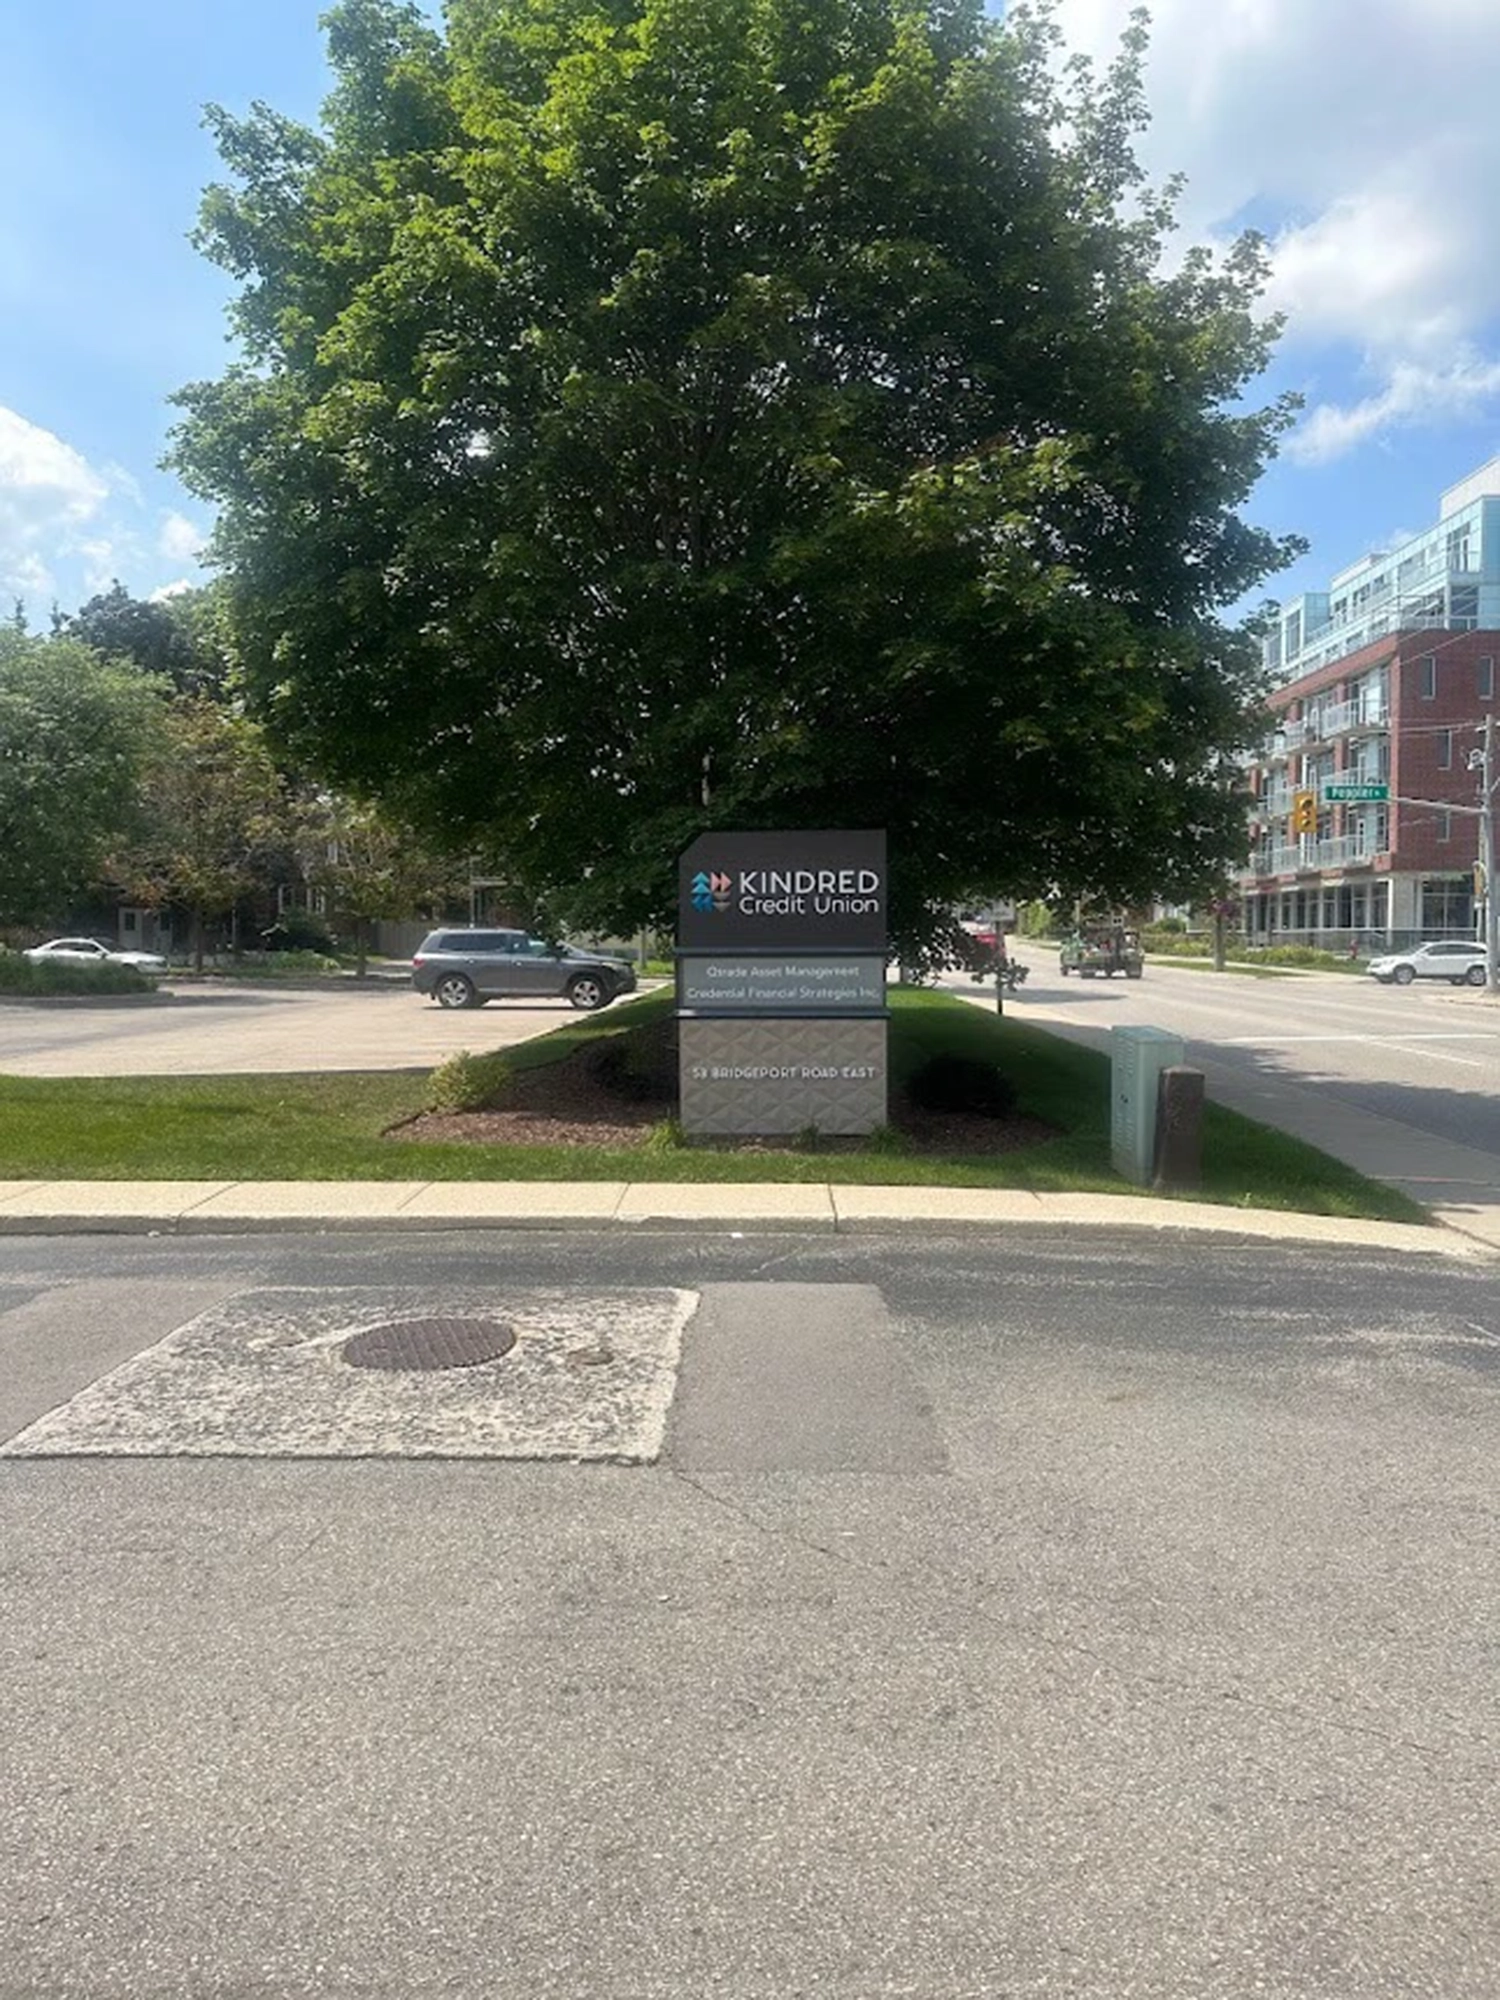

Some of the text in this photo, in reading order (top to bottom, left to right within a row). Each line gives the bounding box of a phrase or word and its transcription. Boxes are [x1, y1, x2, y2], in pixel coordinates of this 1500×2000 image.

[740, 870, 879, 894] KINDRED
[740, 895, 879, 915] Credit Union
[750, 966, 782, 978] Asset
[785, 965, 860, 980] Management
[687, 987, 745, 999] Credential
[748, 986, 797, 999] Financial
[799, 986, 857, 1001] Strategies
[710, 1066, 796, 1080] BRIDGEPORT
[801, 1066, 838, 1080] ROAD
[842, 1066, 876, 1080] EAST
